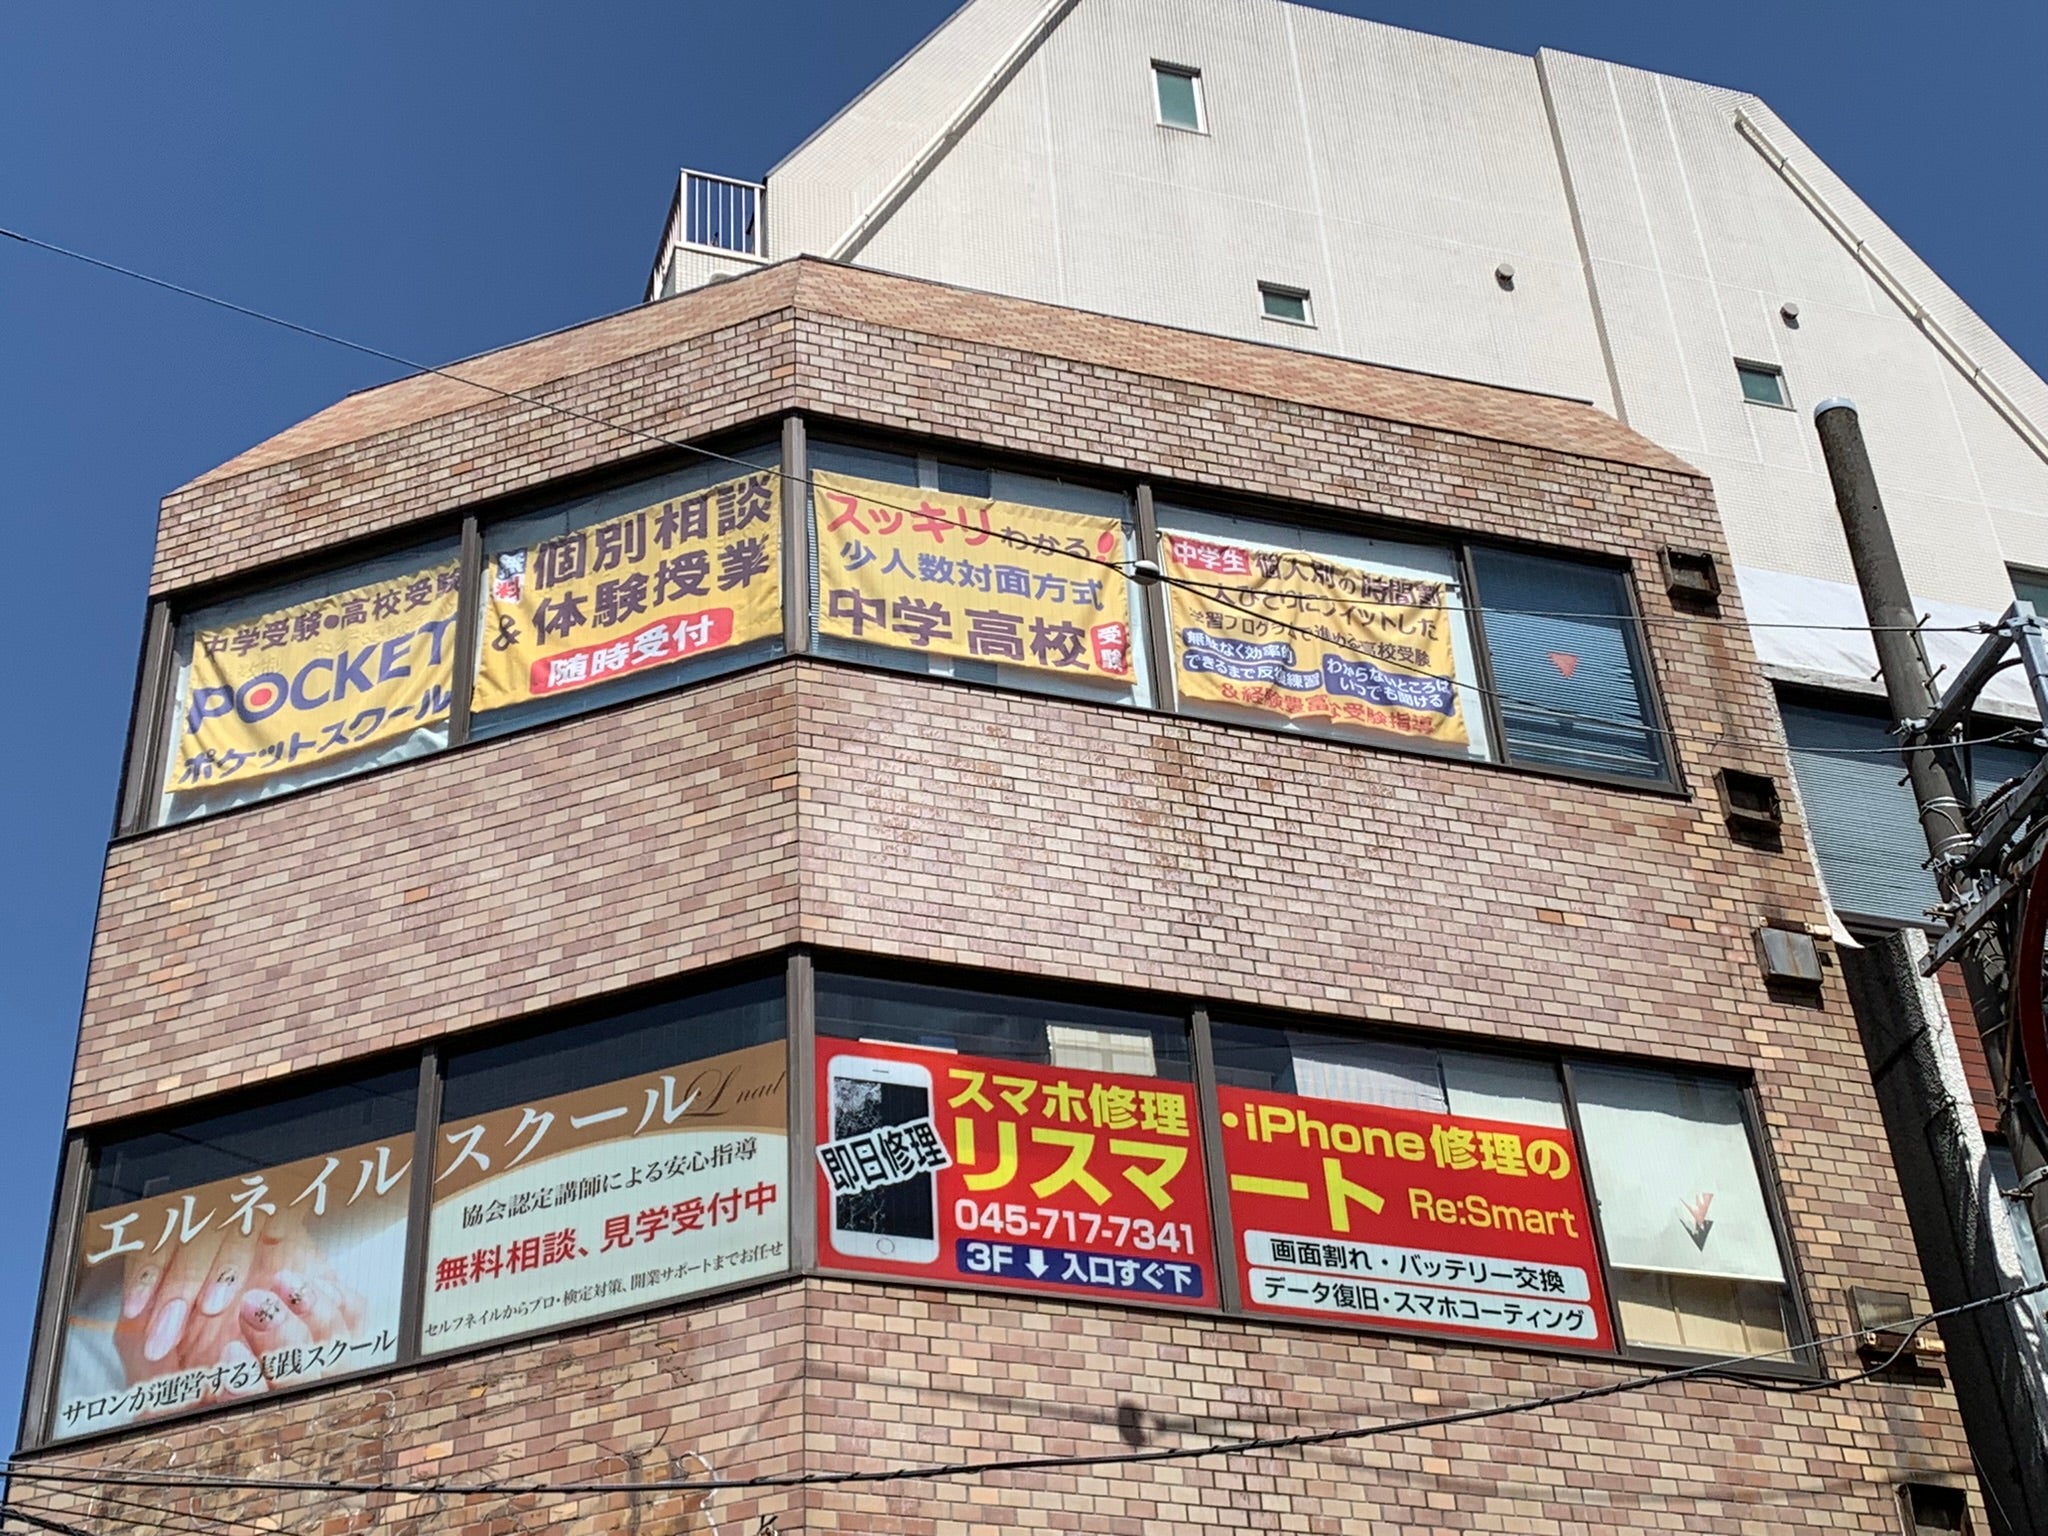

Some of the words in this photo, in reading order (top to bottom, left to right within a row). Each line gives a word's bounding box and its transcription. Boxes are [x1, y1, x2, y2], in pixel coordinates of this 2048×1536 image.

[533, 475, 772, 590] 個別相談
[1172, 541, 1248, 573] 中学生
[840, 539, 1104, 611] 少人数対面方式
[187, 616, 457, 734] POCKET
[547, 615, 714, 687] 随時受付
[179, 683, 451, 784] ポケットスクール
[462, 1136, 758, 1229] 協会認定講師による安心指導
[820, 1121, 947, 1191] 即日修理
[955, 1199, 1195, 1254] 045-717-7341
[1408, 1188, 1579, 1239] Re:Smart
[967, 1242, 1013, 1272] 3F
[1061, 1256, 1192, 1293] 入口すぐ下
[62, 1329, 397, 1427] サロンが運営する実践スクール
